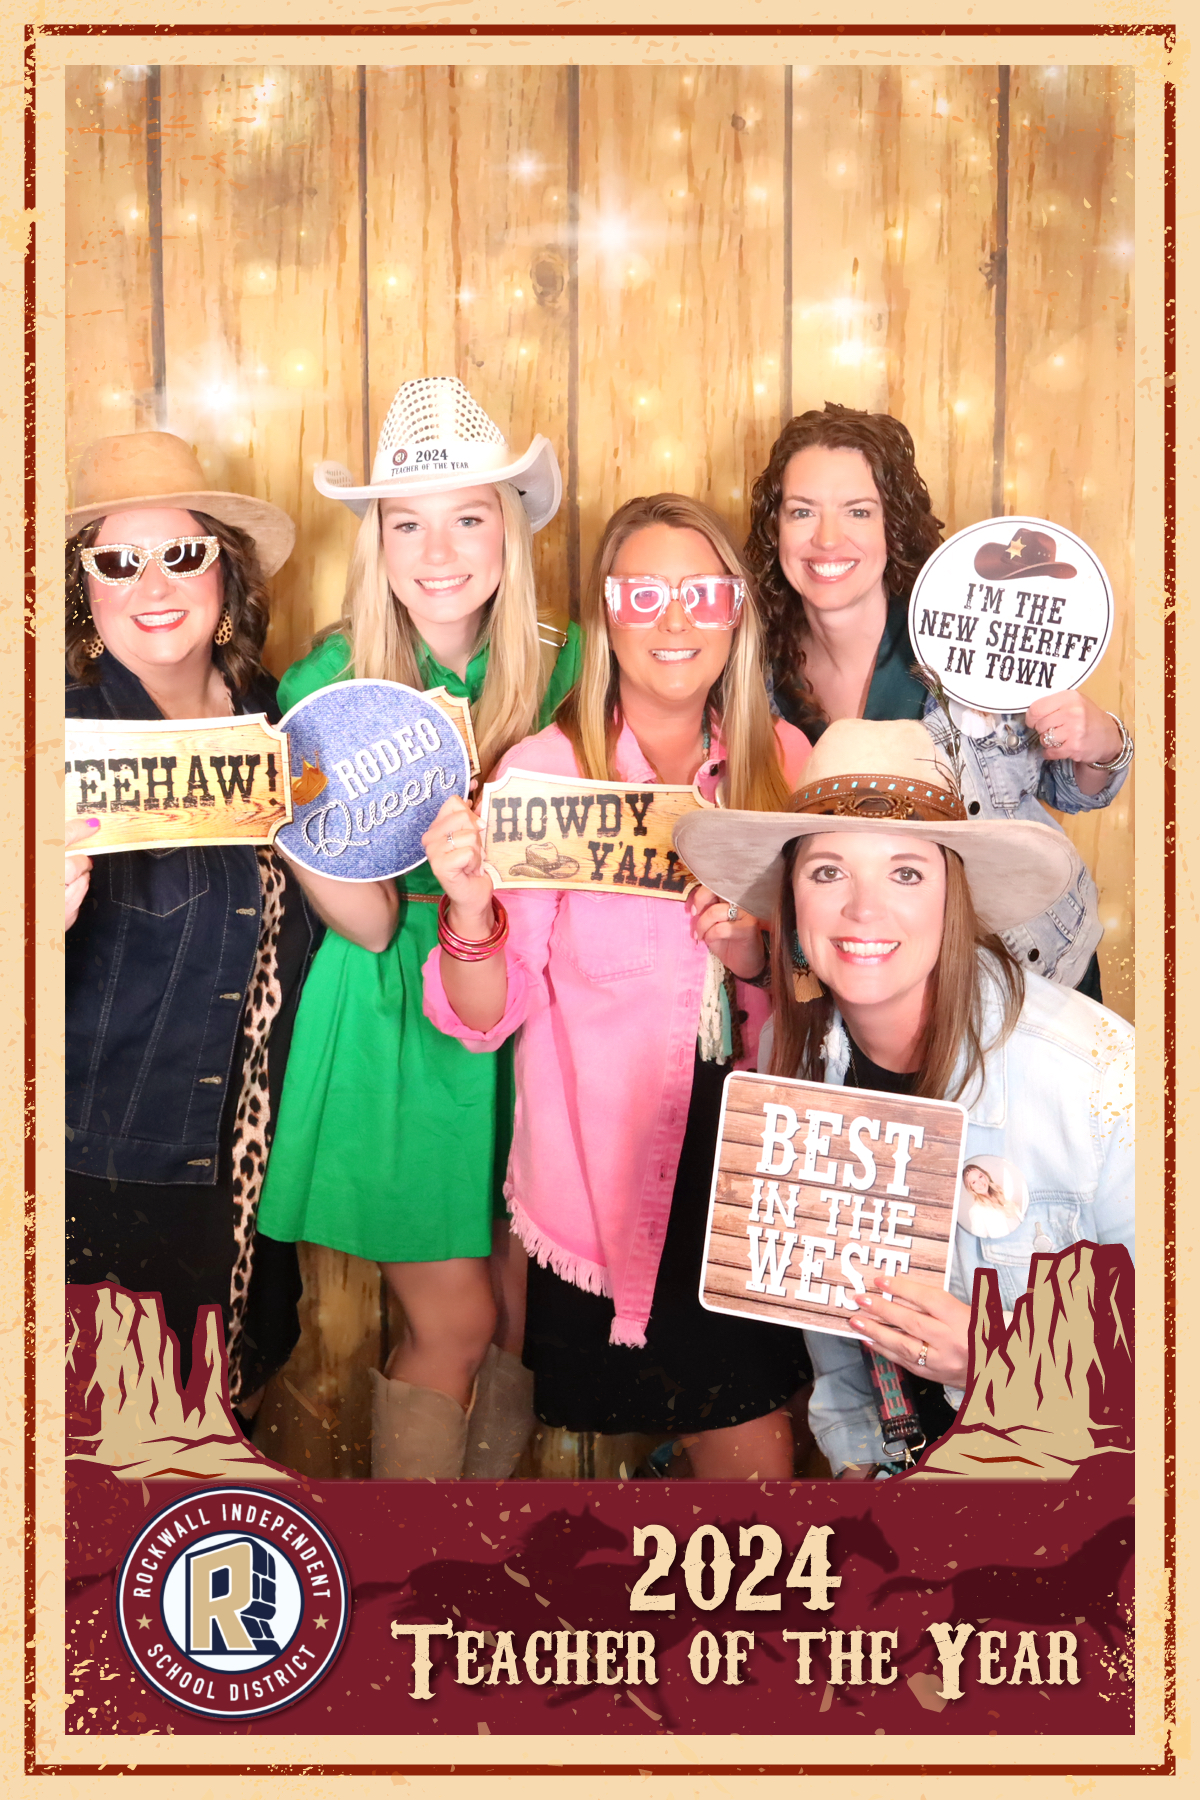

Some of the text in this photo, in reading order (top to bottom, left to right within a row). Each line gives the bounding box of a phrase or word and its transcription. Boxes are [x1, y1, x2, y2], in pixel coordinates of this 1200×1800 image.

[391, 461, 469, 477] TEACHER OF THE YEAR
[415, 449, 448, 463] 2024
[964, 583, 1066, 624] I'M THE
[918, 609, 1098, 662] NEW SHERIFF
[944, 646, 1057, 689] IN TOWN
[65, 754, 279, 814] EEHAW!
[332, 718, 442, 801] RODEO
[302, 766, 456, 857] Queen
[492, 792, 654, 843] HOWDY
[588, 840, 686, 893] Y'ALL
[756, 1102, 925, 1197] BEST
[748, 1178, 917, 1249] IN THE
[745, 1225, 911, 1311] WEST
